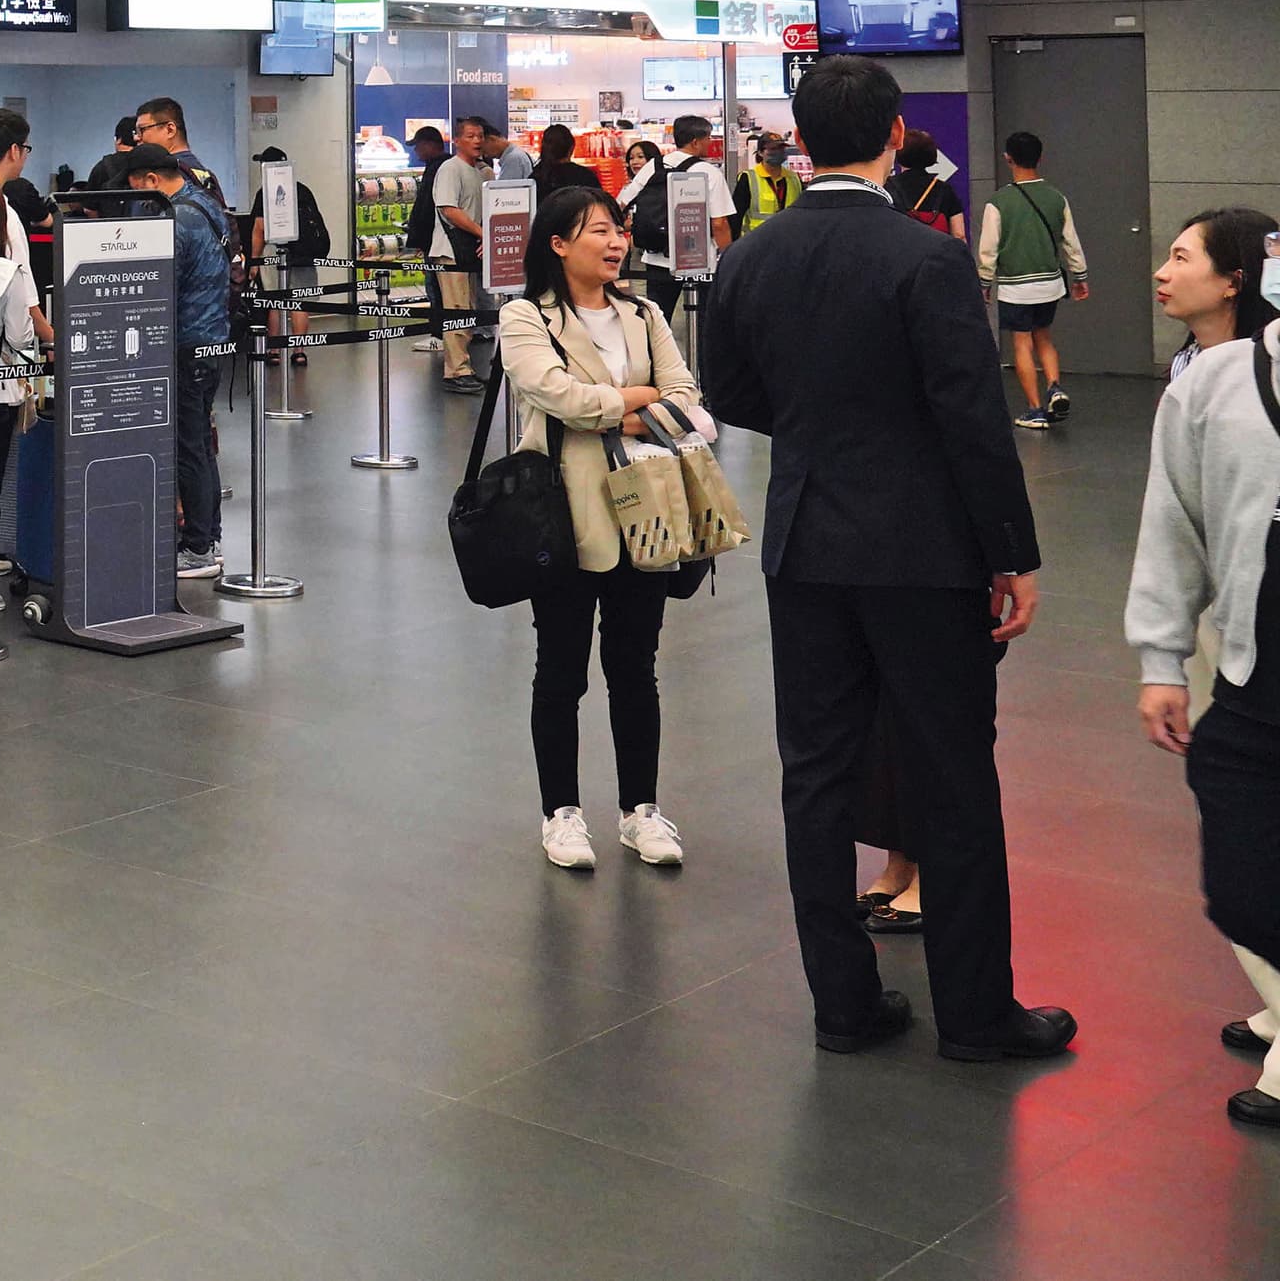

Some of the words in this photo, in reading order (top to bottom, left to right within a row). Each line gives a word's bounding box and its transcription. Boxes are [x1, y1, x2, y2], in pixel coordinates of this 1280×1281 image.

[723, 1, 758, 36] 全家
[456, 69, 481, 84] Food
[484, 71, 503, 84] area
[494, 225, 522, 233] PREMIUM
[101, 242, 138, 252] STARLUX
[313, 258, 355, 268] STARLUX
[402, 262, 446, 272] STARLUX
[79, 273, 121, 285] CARRY-ON
[122, 271, 159, 283] BAGGAGE
[291, 286, 324, 298] STARLUX
[253, 298, 302, 311] STARLUX
[358, 305, 411, 318] STARLUX
[442, 316, 477, 331] STARLUX
[368, 326, 406, 340] STARLUX
[288, 334, 327, 347] STARLUX
[194, 342, 237, 359] STARLUX
